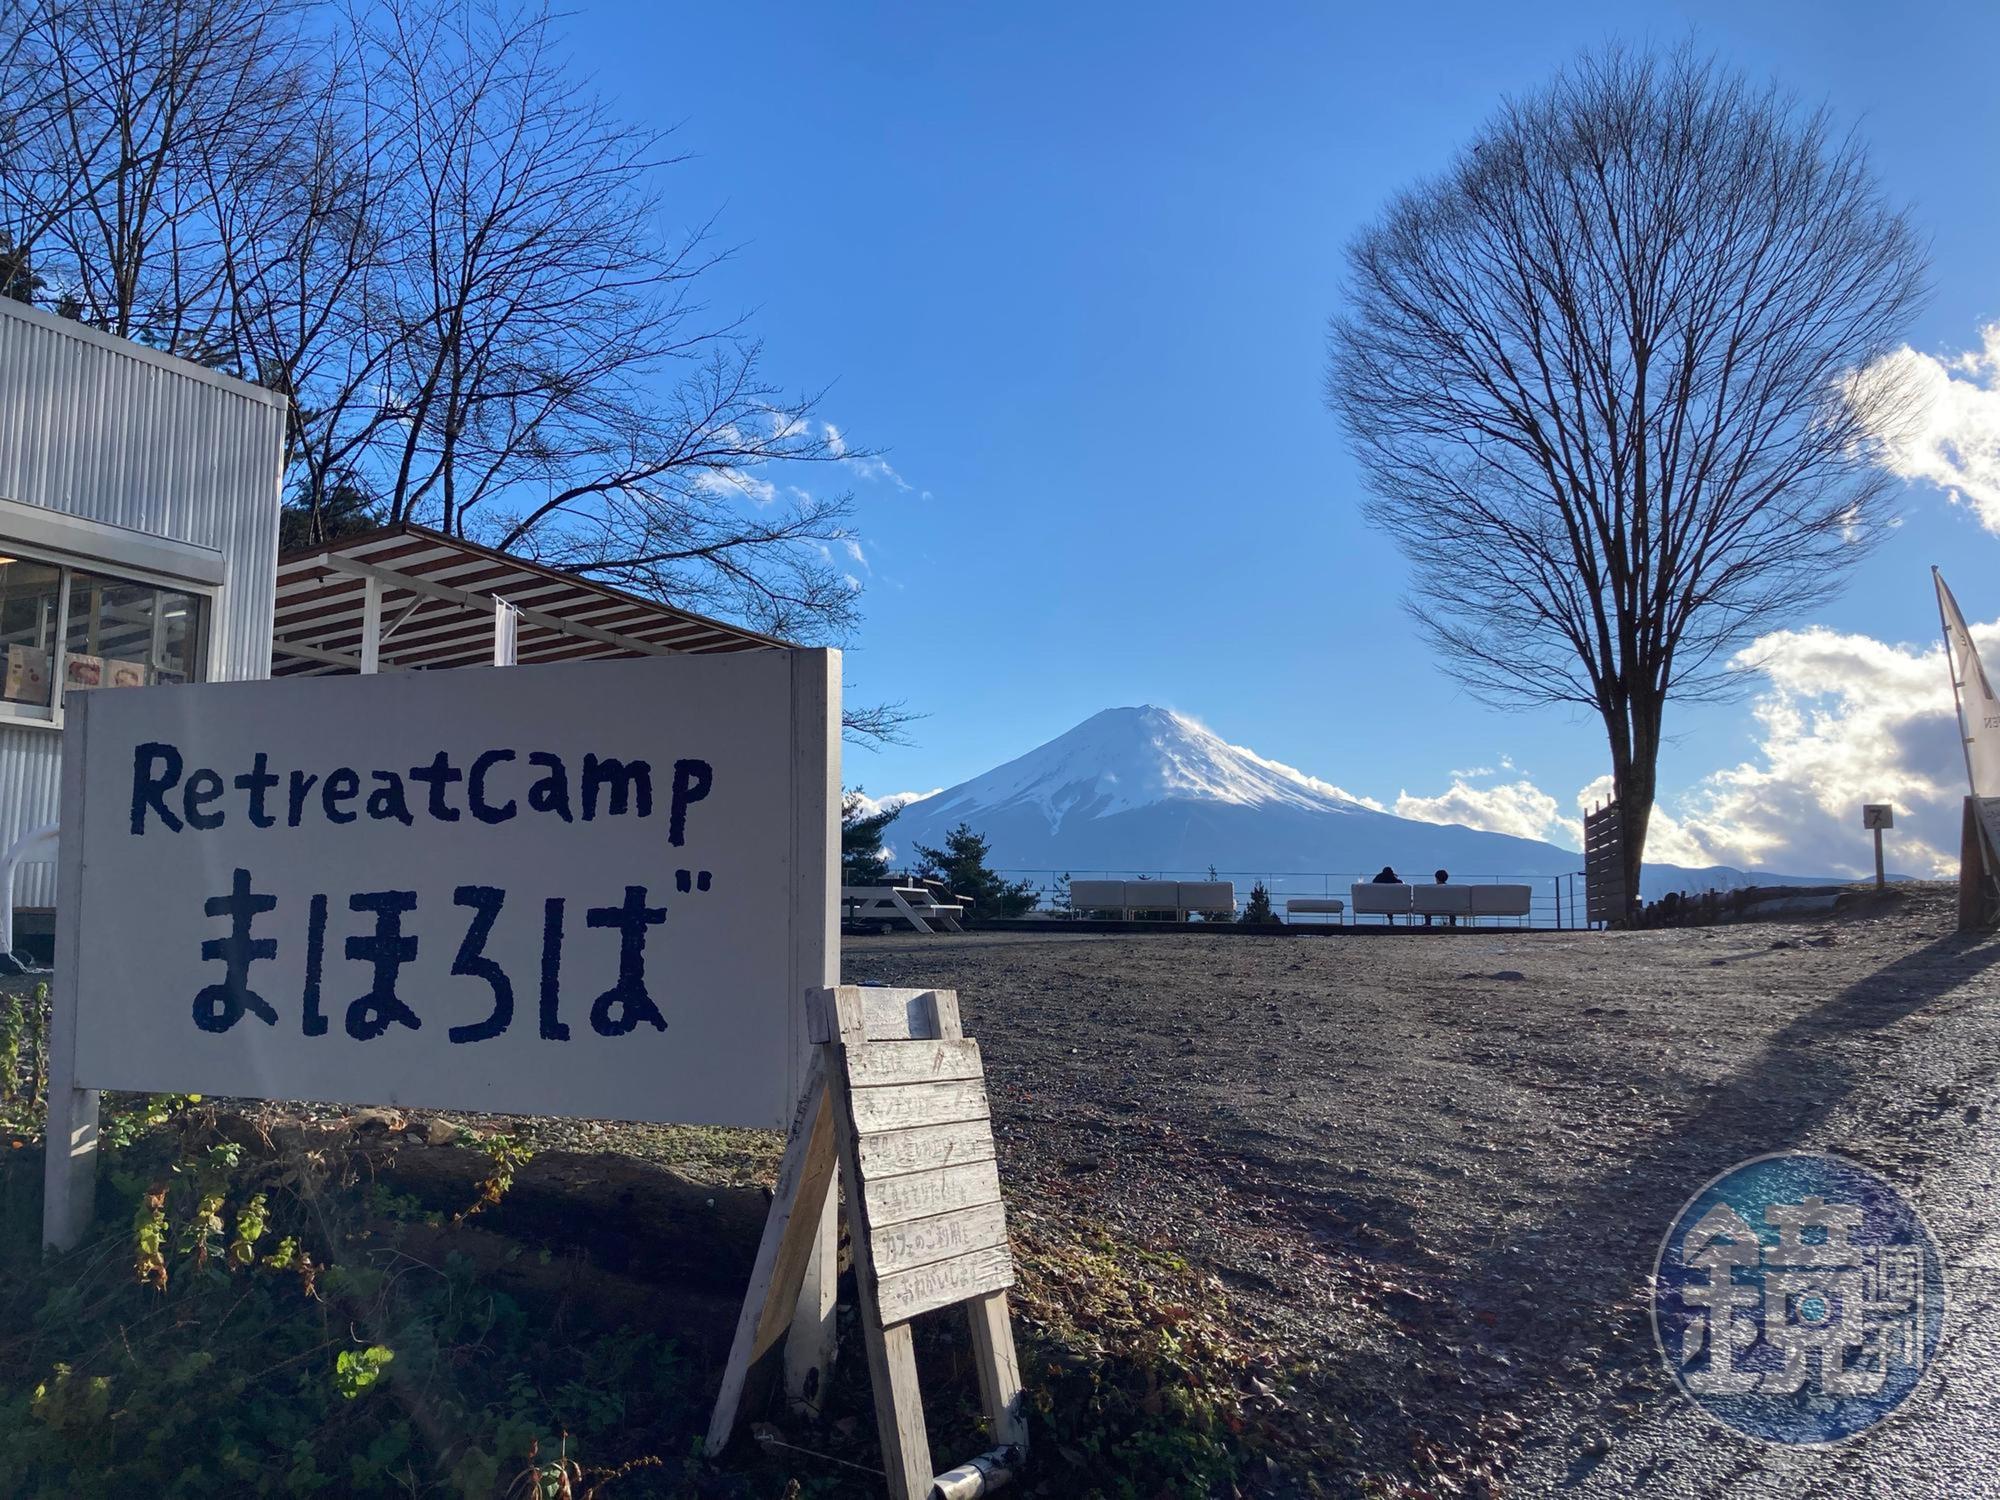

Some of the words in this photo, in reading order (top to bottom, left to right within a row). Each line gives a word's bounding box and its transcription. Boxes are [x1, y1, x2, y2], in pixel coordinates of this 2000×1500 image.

[130, 741, 713, 847] RetreatCamp
[192, 867, 713, 1044] まほろば
